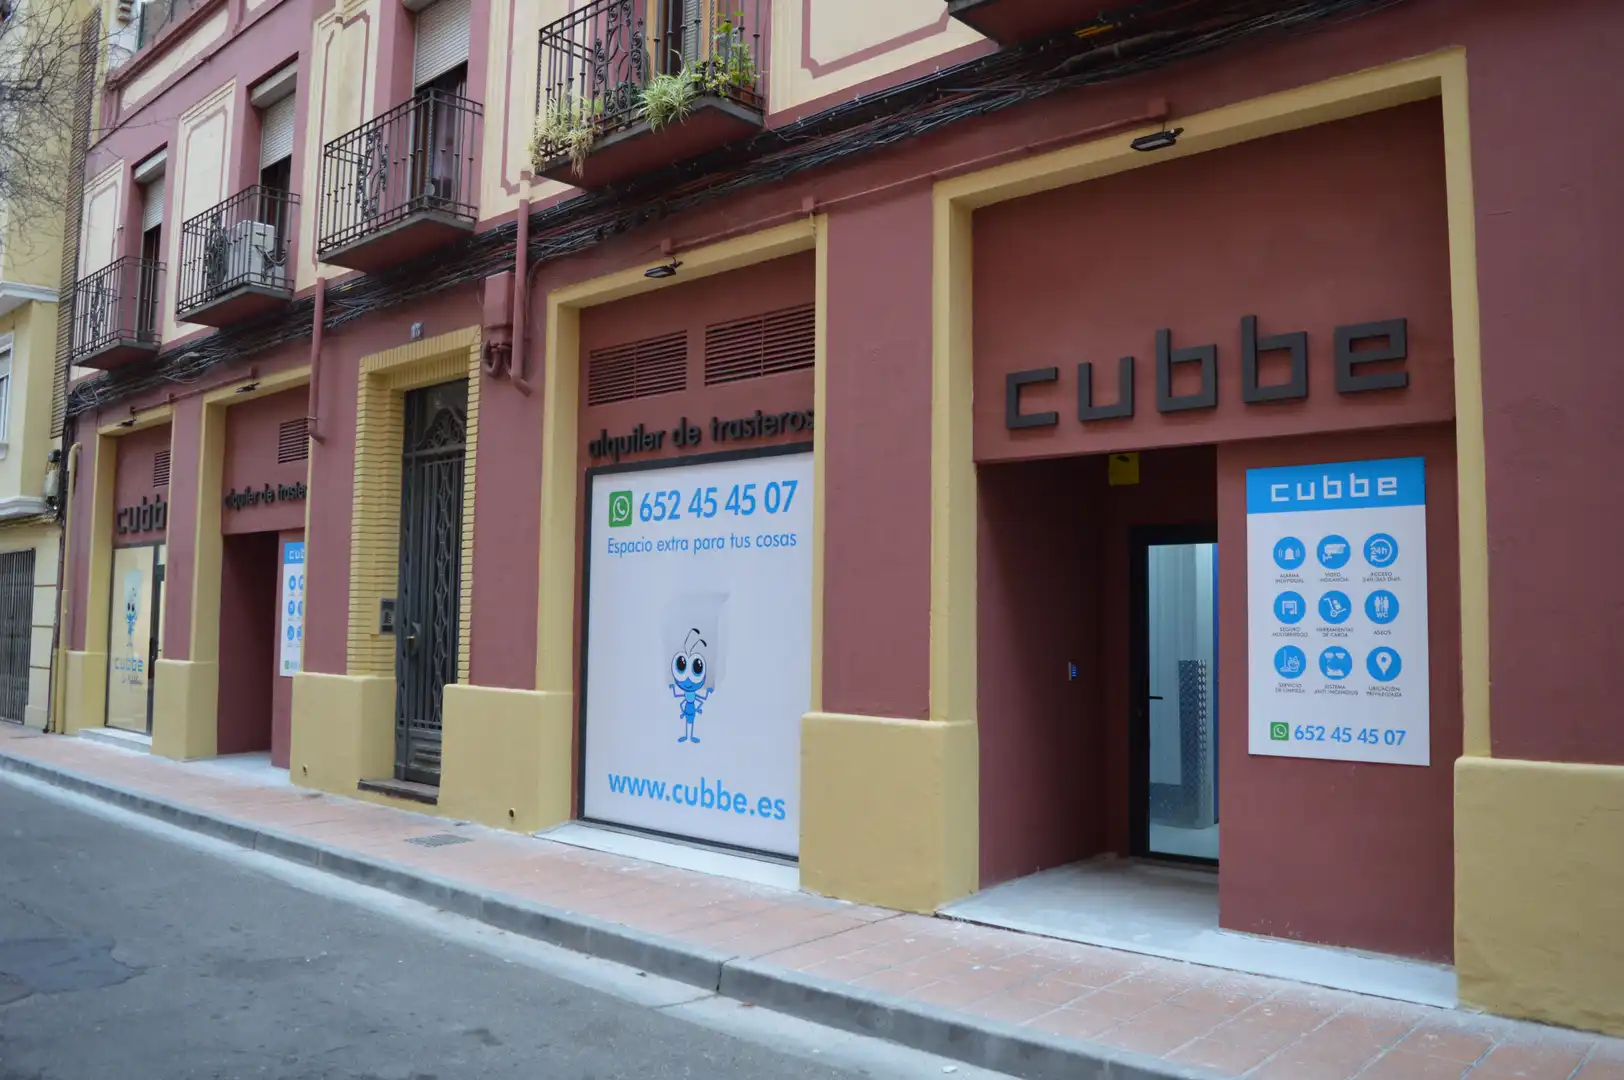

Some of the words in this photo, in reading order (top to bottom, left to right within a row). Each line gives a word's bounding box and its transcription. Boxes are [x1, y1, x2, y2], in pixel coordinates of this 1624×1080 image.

[1005, 314, 1409, 430] cubbe
[589, 423, 666, 463] alquiler
[671, 417, 702, 447] de
[639, 489, 682, 522] 652
[688, 487, 718, 519] 45
[724, 484, 757, 516] 45
[764, 480, 798, 515] 07
[1271, 472, 1398, 502] cubbe
[607, 536, 653, 558] Espacio
[656, 535, 689, 552] extra
[693, 536, 725, 555] para
[730, 532, 751, 549] tus
[755, 531, 797, 549] cosas
[1294, 725, 1325, 741] 652
[1331, 727, 1352, 743] 45
[1357, 728, 1379, 744] 45
[1384, 729, 1406, 745] 07
[608, 773, 786, 821] www.cubbe.es
